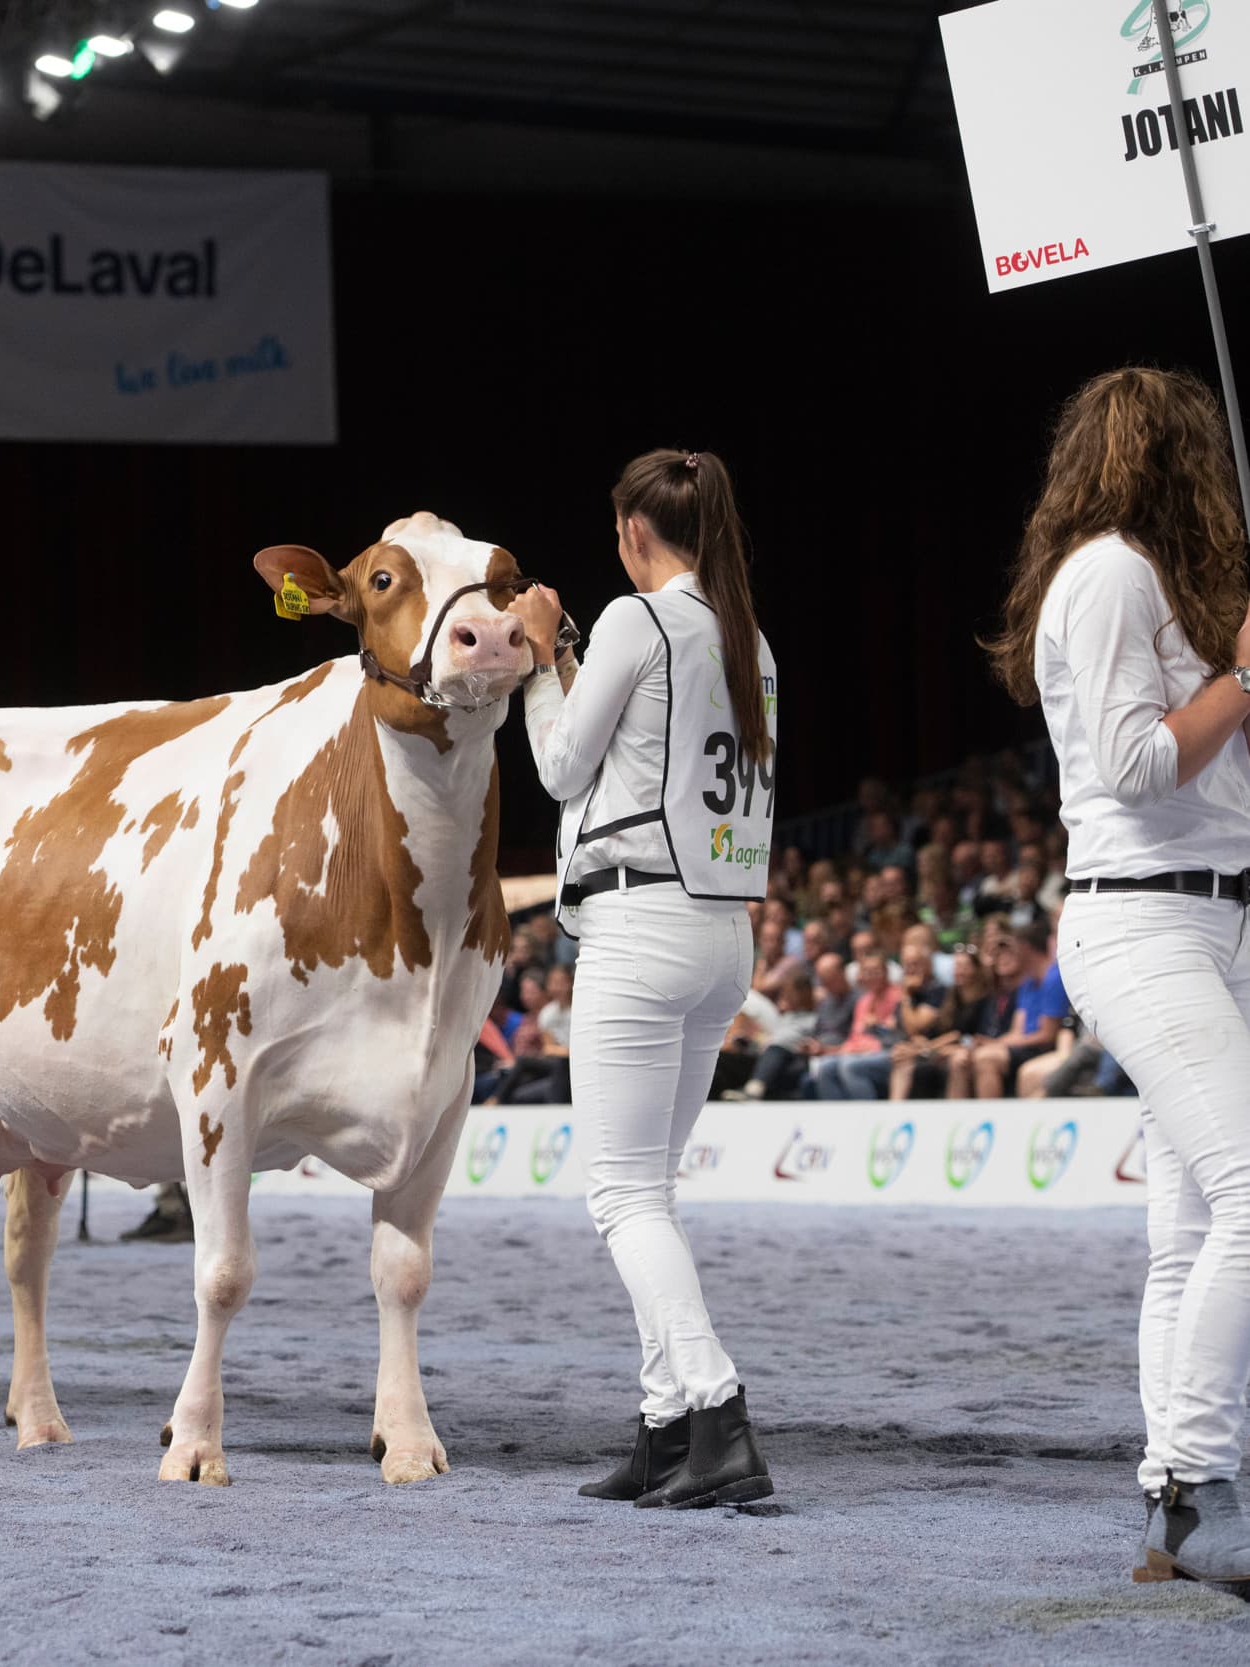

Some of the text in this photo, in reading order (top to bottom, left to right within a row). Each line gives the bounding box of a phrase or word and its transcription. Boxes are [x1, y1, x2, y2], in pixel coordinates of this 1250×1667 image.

[1134, 51, 1207, 76] K.I.KMPEN
[1121, 88, 1244, 161] JOTANI
[995, 238, 1089, 276] BOVELA
[702, 731, 776, 818] 399
